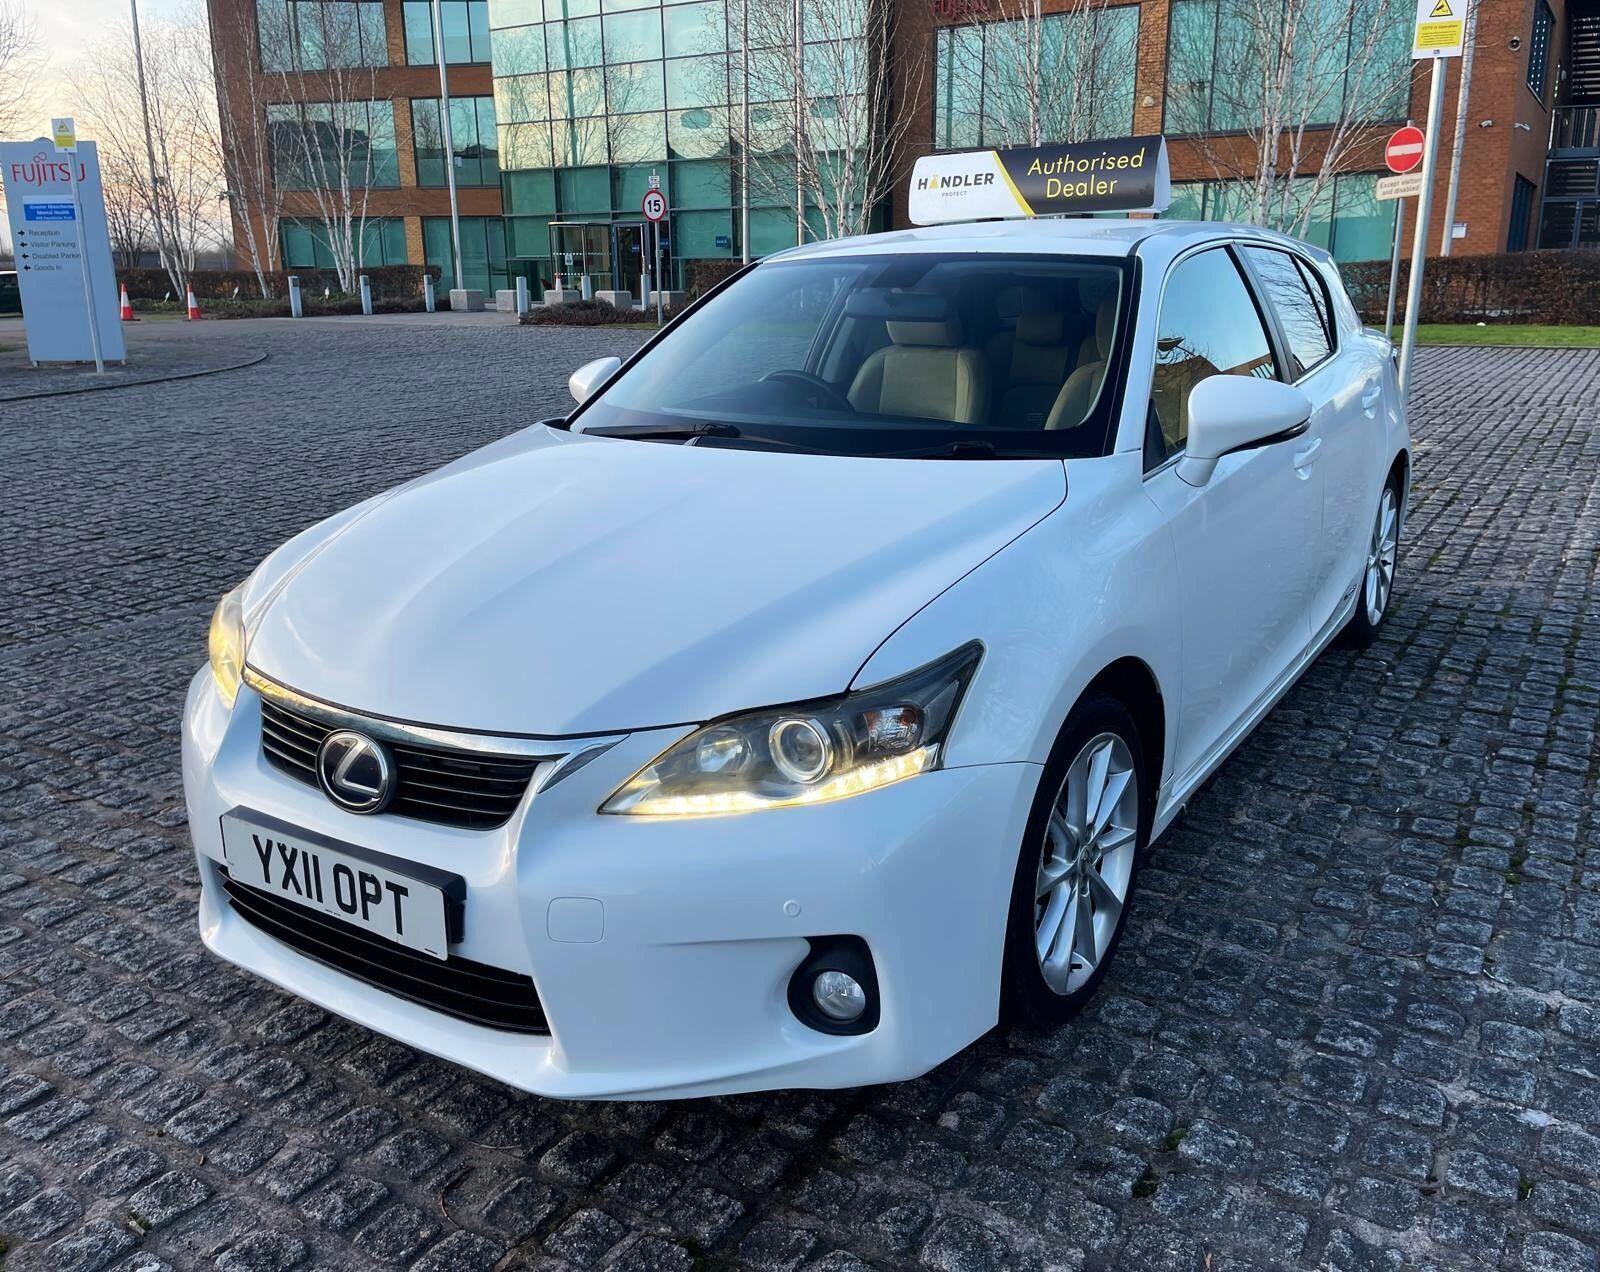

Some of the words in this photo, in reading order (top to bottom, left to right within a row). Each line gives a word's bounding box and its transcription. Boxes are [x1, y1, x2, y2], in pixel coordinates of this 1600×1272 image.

[1027, 147, 1146, 176] Authorised
[1046, 173, 1118, 199] Dealer
[647, 200, 661, 213] 15
[252, 834, 324, 904] YX11
[332, 863, 409, 936] OPT
